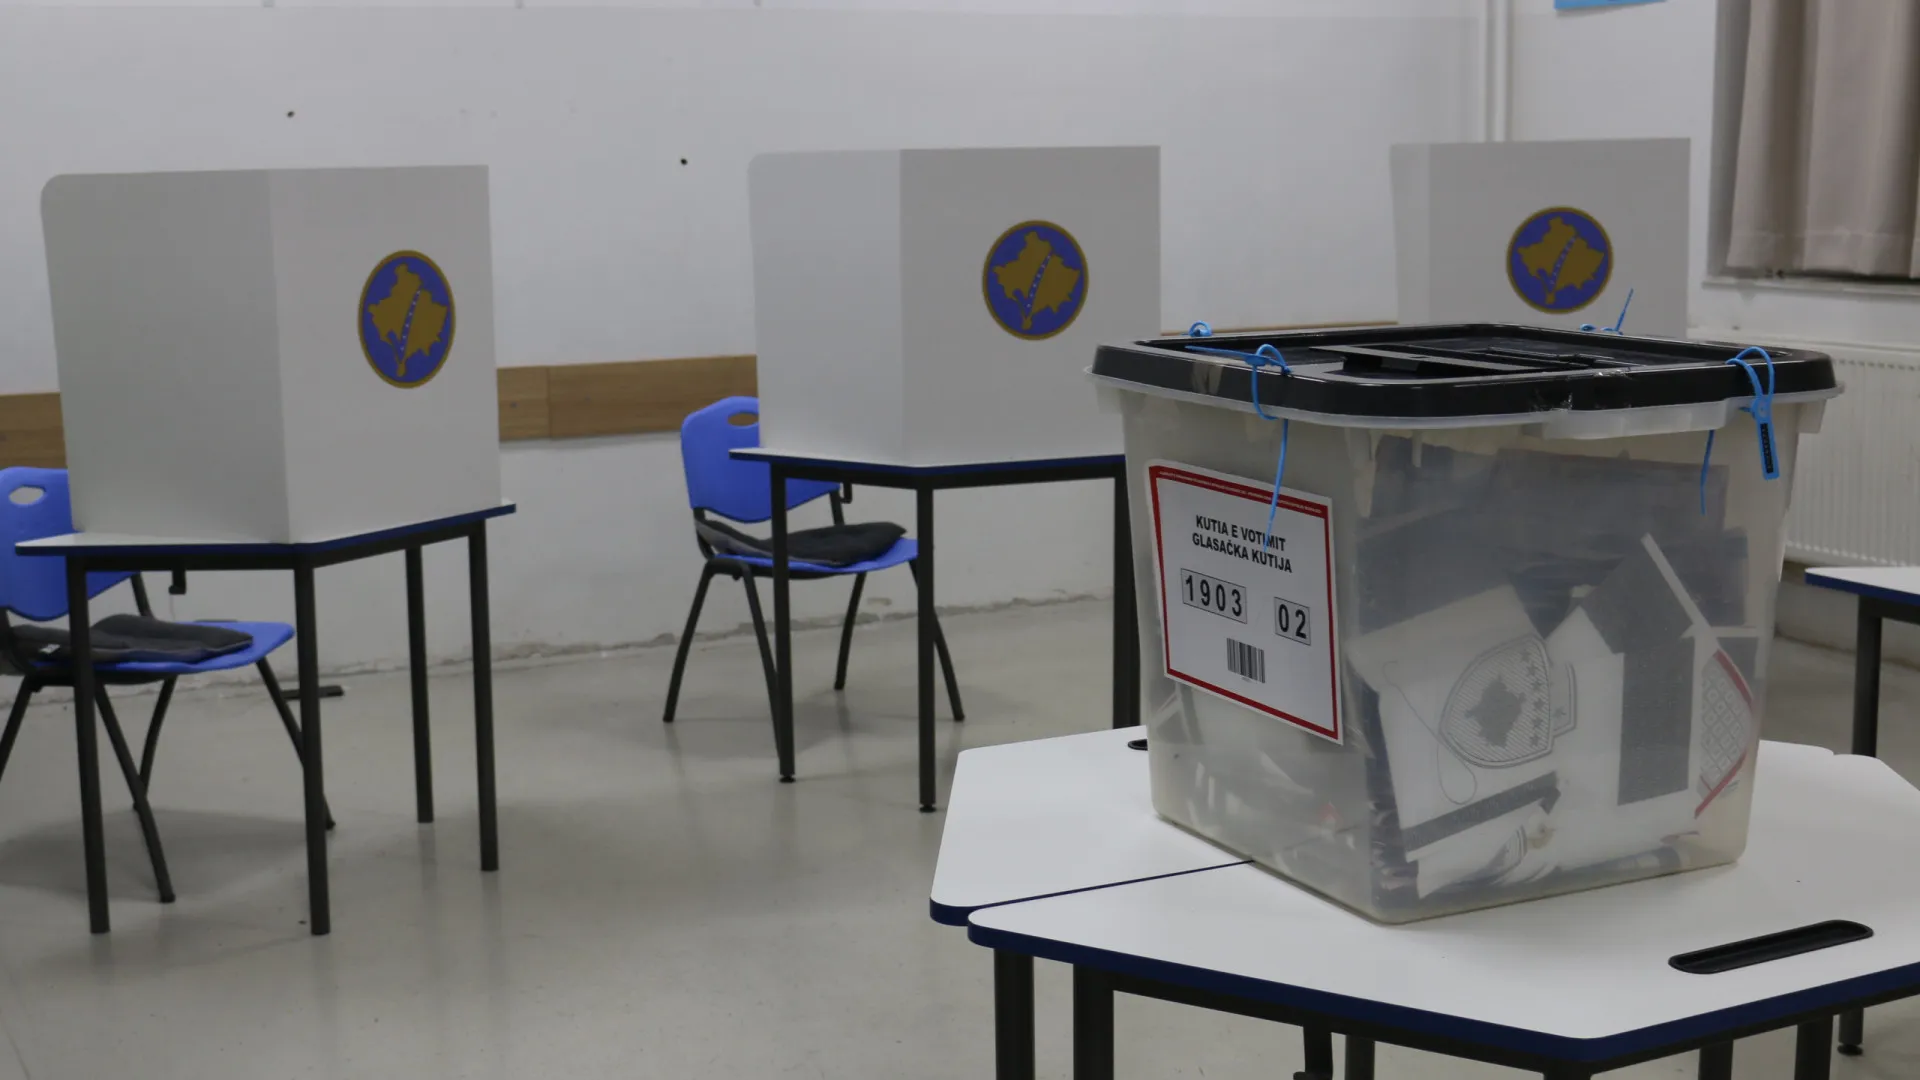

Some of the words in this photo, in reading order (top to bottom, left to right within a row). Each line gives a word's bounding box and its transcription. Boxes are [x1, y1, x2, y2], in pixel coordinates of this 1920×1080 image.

[1196, 514, 1229, 536] KUTIA
[1231, 524, 1238, 539] E
[1240, 526, 1286, 551] VOTIMIT
[1192, 532, 1249, 561] GLASAČKA
[1251, 548, 1293, 573] KUTIJA
[1185, 575, 1242, 617] 1903
[1278, 603, 1308, 639] 02
